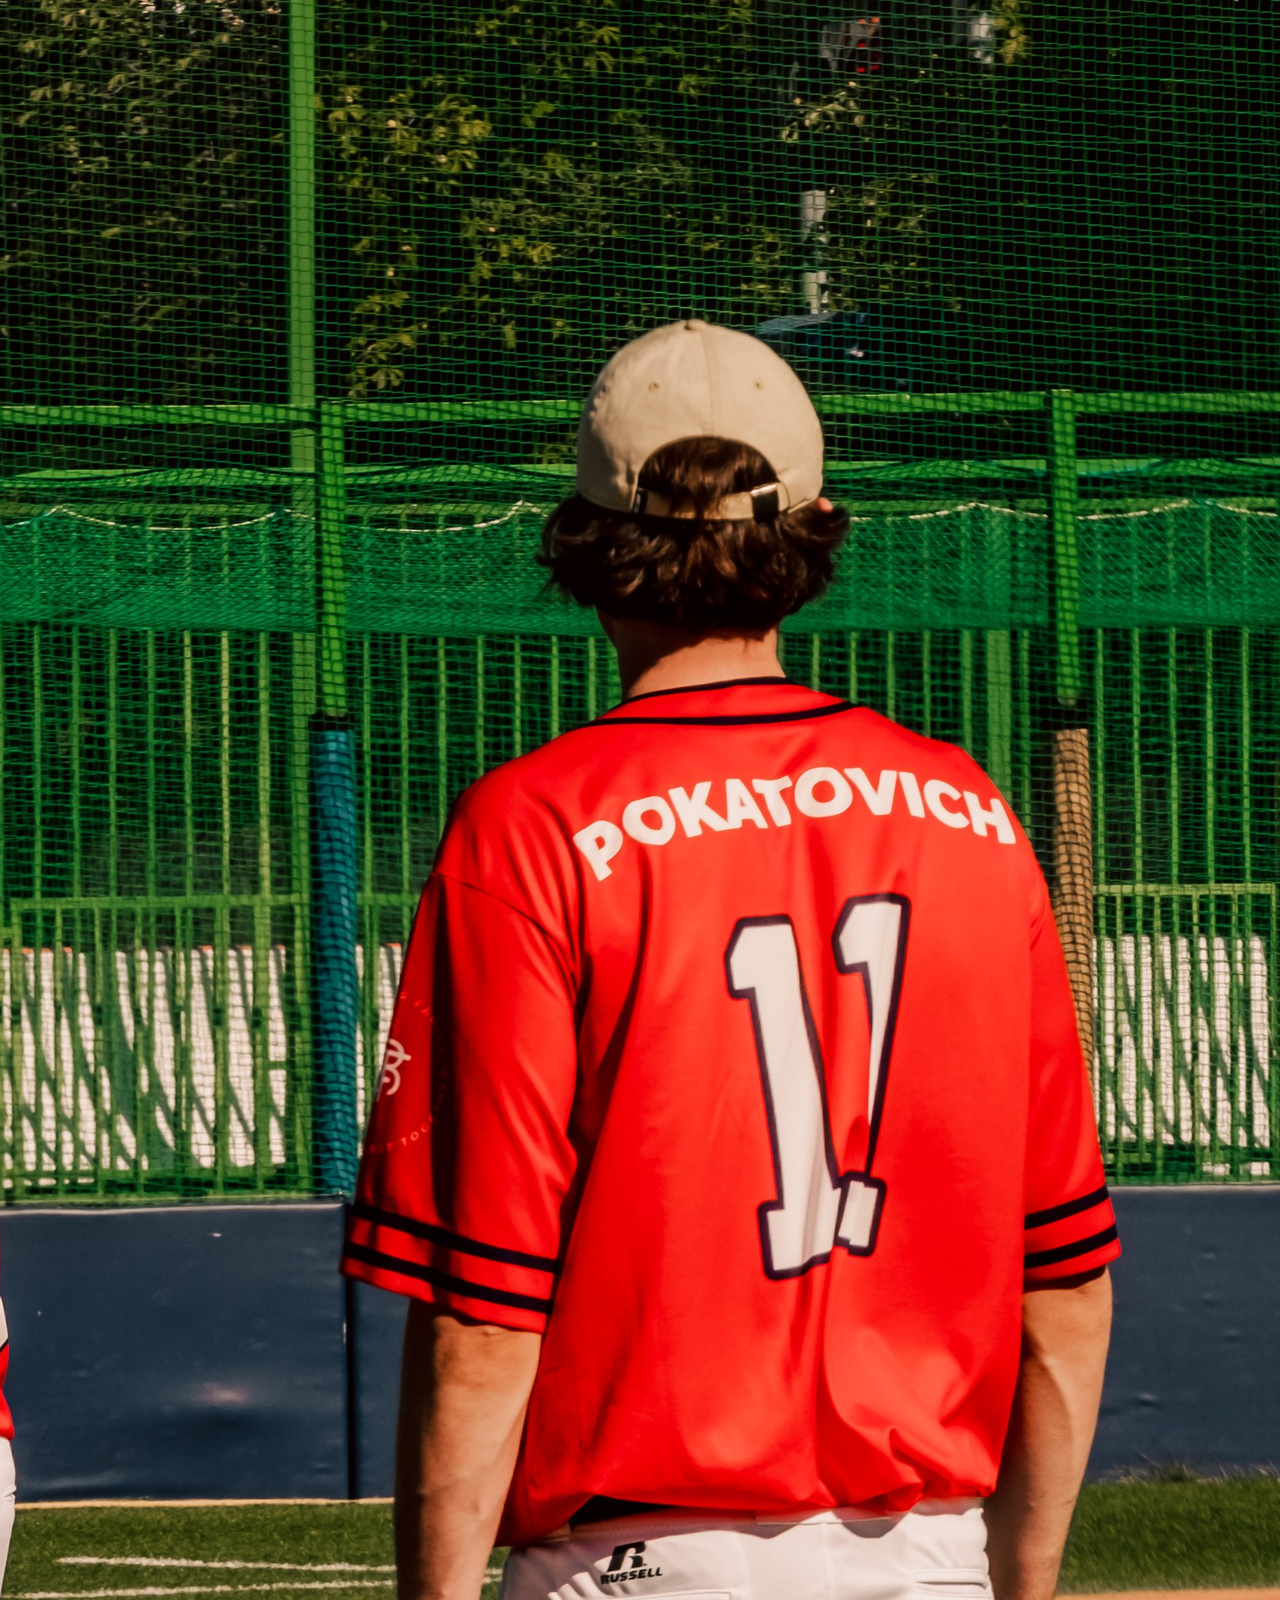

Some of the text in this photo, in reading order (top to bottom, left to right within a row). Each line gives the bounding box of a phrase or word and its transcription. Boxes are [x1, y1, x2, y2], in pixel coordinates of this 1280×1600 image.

[573, 766, 1016, 881] POKATOVICH
[724, 892, 912, 1281] 11
[600, 1566, 663, 1585] RUSSELL
